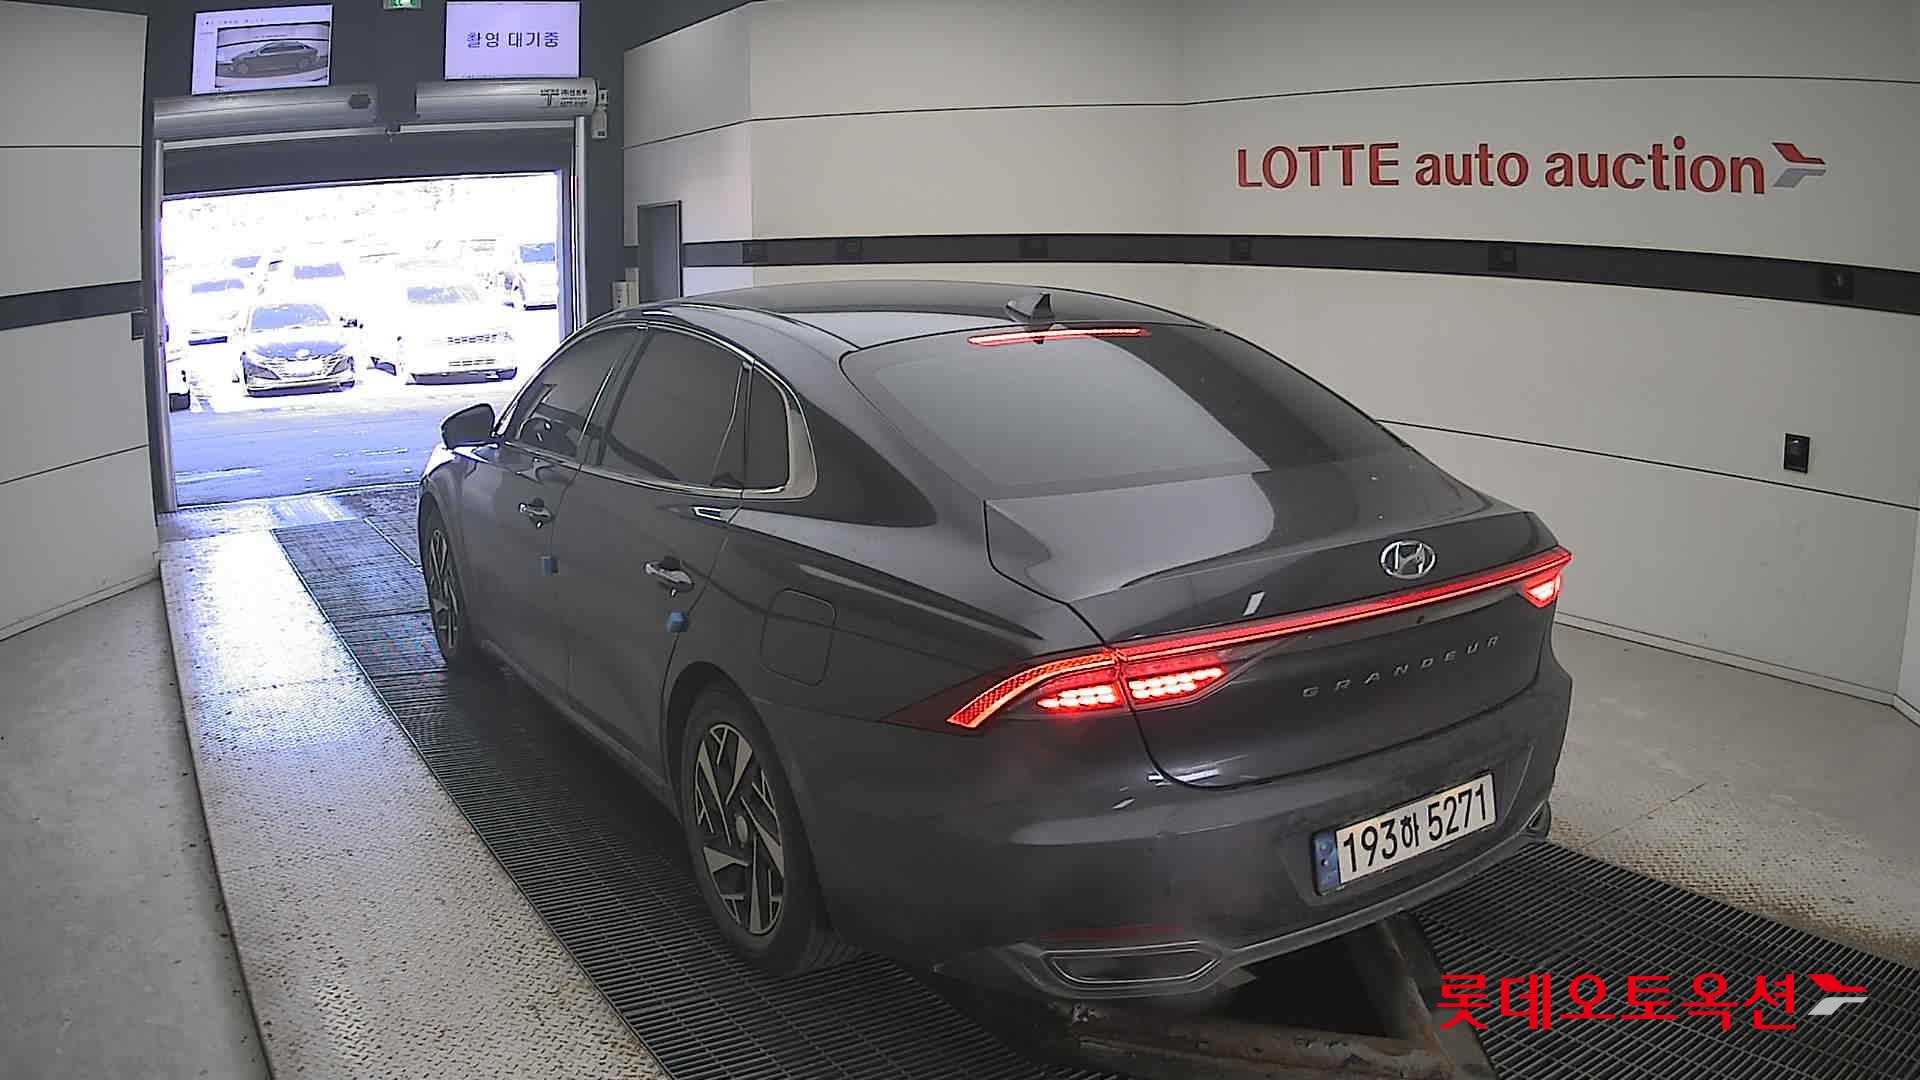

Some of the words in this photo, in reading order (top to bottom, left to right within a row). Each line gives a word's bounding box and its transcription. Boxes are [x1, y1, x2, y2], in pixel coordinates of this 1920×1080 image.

[466, 32, 499, 48] 촬영
[508, 32, 560, 48] 대기중
[1237, 142, 1400, 189] LOTTE
[1415, 143, 1529, 188] auto
[1545, 135, 1766, 195] auction
[1302, 635, 1499, 697] GRANDEUR
[1343, 812, 1420, 873] 193하
[1426, 783, 1487, 842] 5271
